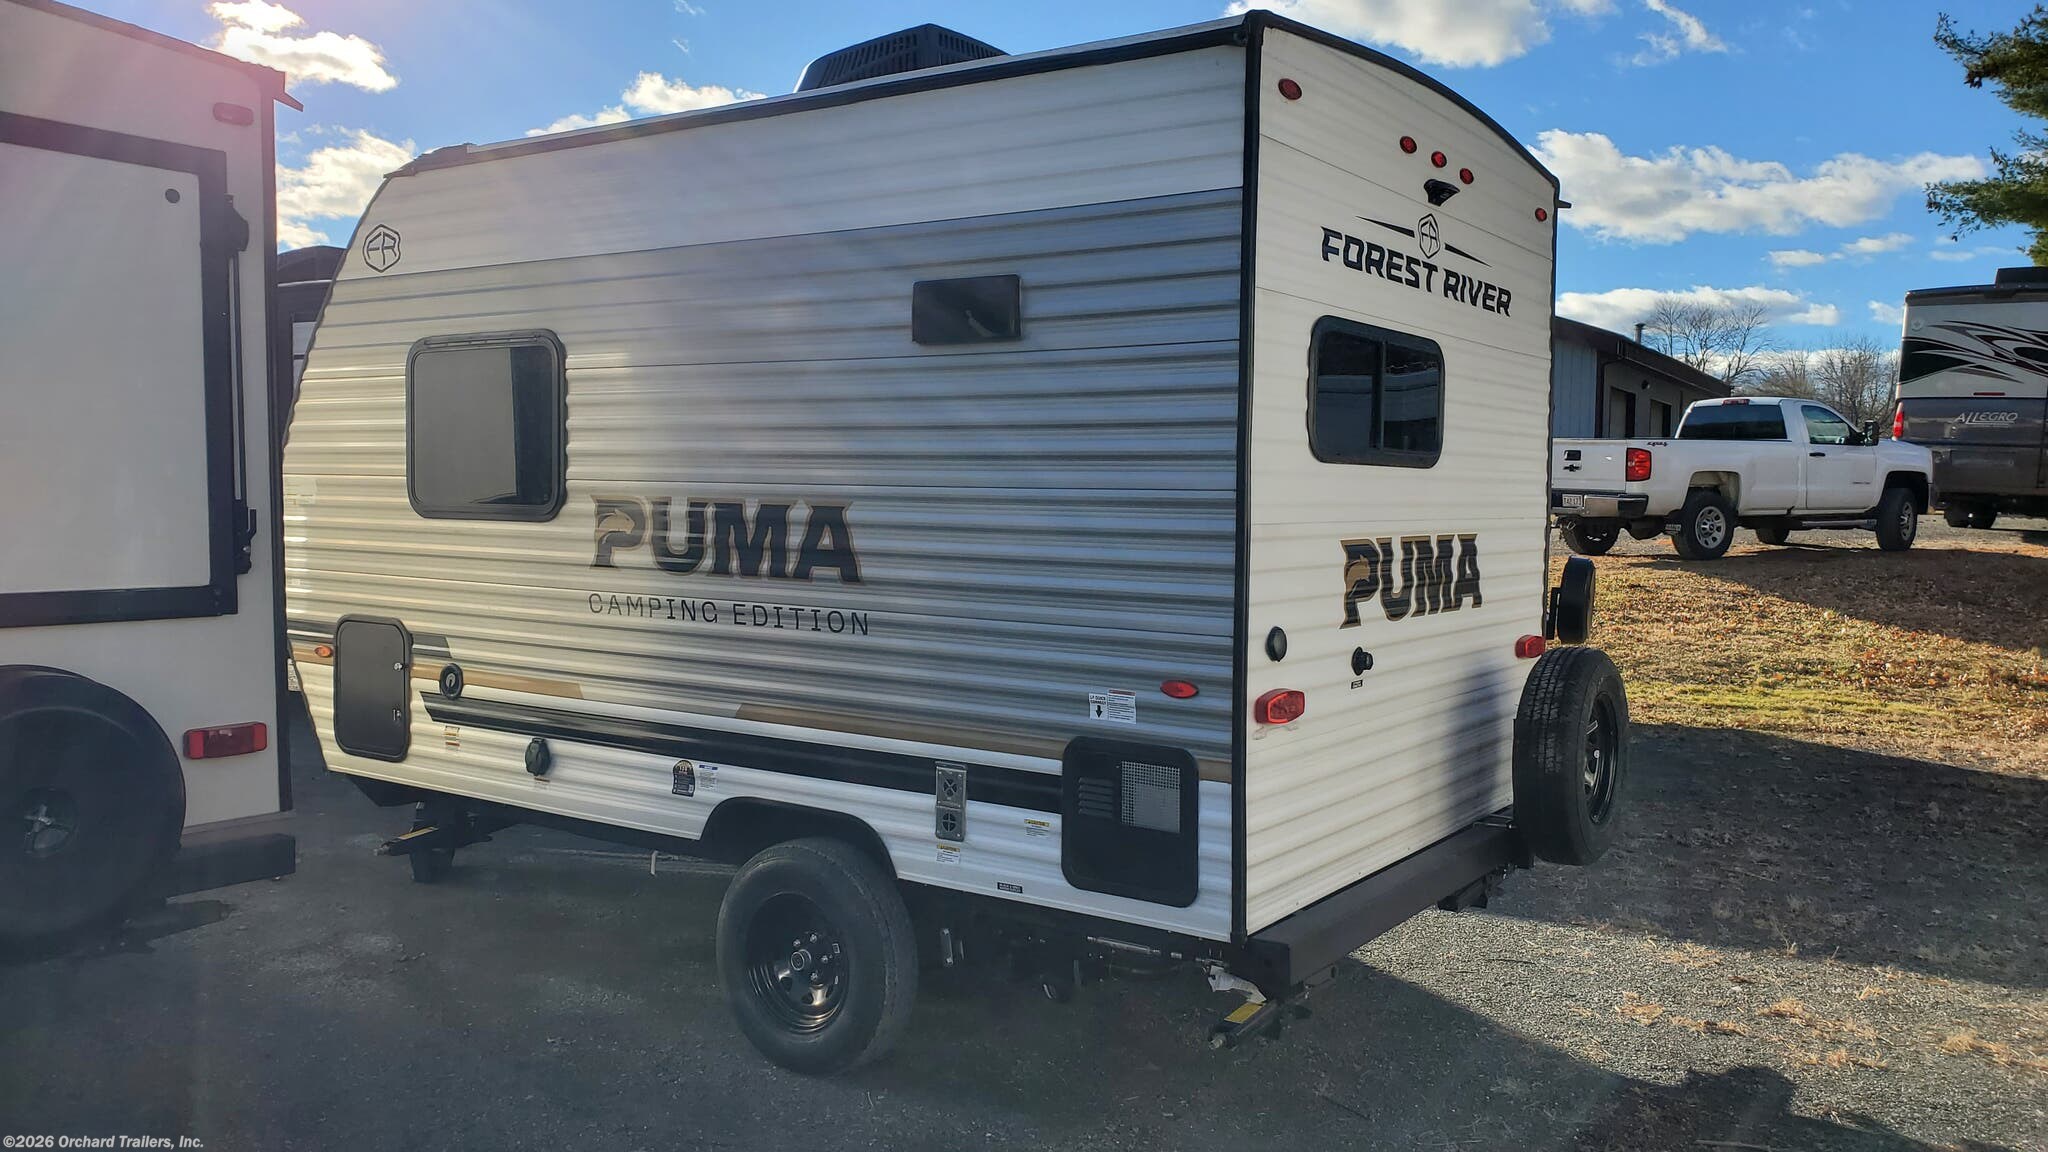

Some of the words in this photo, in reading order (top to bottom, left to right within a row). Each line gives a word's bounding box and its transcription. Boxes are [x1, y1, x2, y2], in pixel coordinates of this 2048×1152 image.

[1320, 226, 1439, 293] FOREST
[1442, 267, 1512, 317] RIVER
[1954, 412, 2018, 425] ALLEGRO
[589, 494, 865, 585] PUMA
[1339, 533, 1483, 630] PUMA
[588, 592, 719, 624] CAMPING
[732, 603, 869, 636] EDITION
